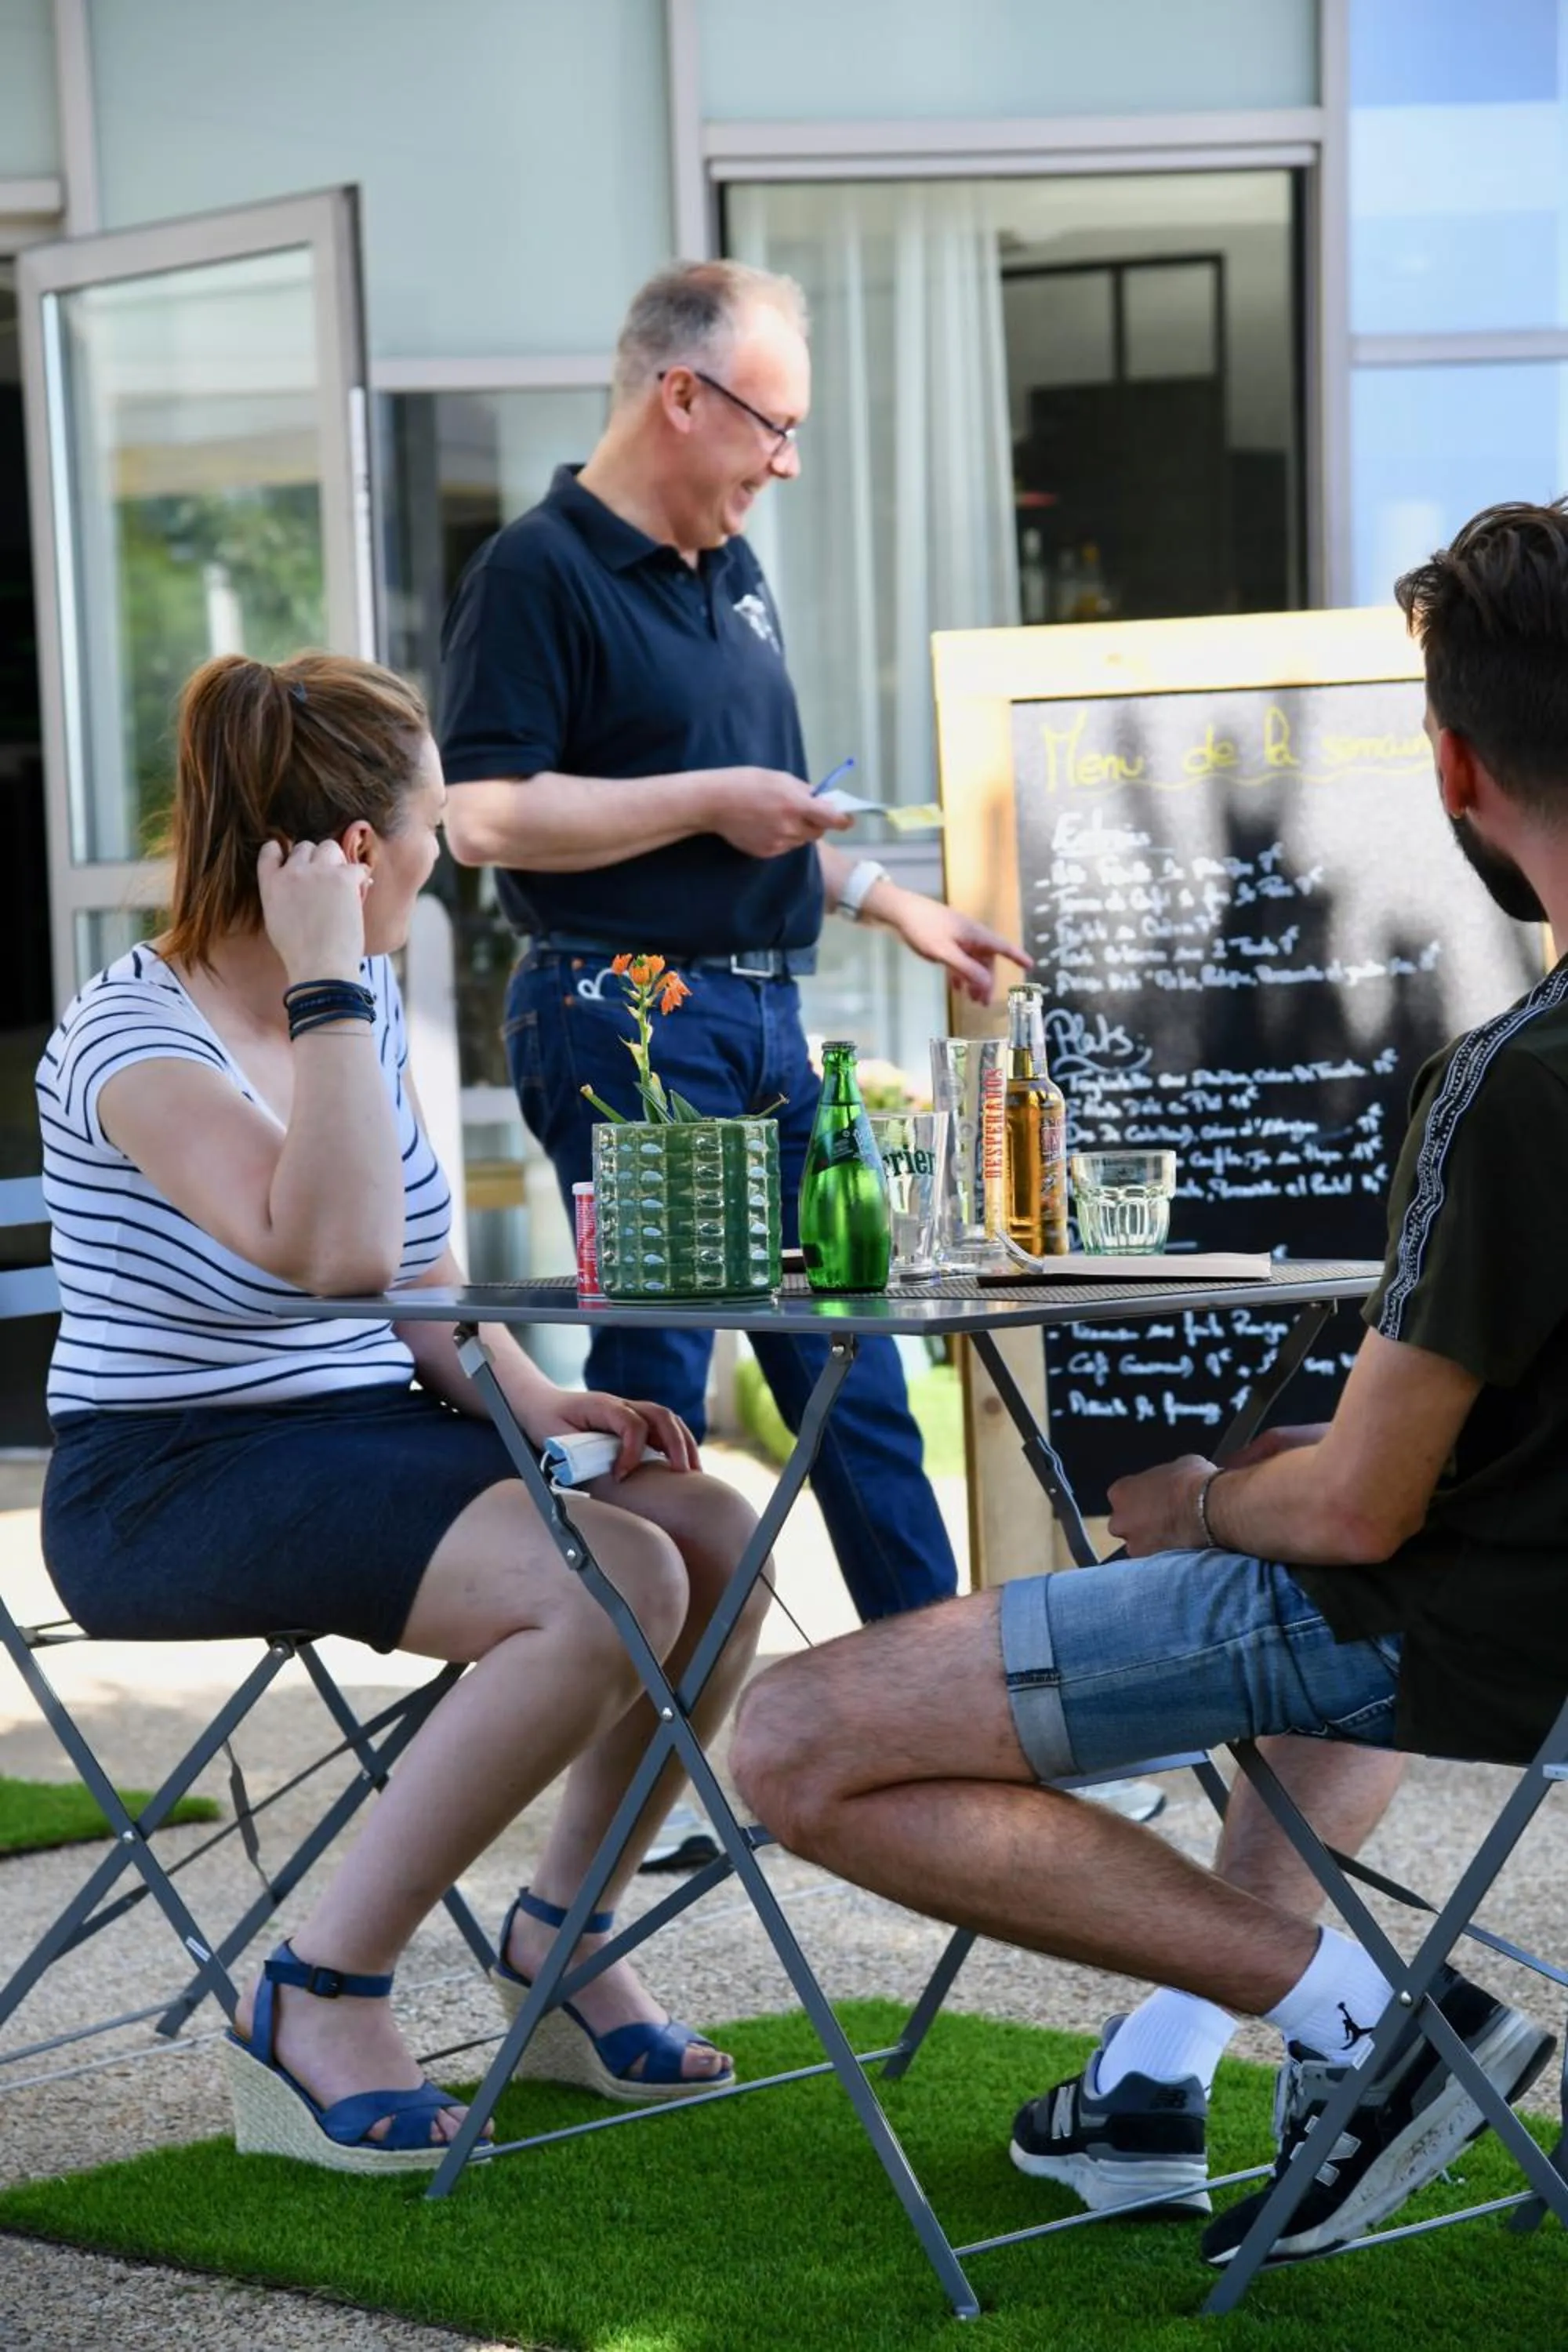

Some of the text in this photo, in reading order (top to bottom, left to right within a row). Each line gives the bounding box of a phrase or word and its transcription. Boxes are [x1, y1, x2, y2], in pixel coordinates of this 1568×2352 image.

[1042, 705, 1432, 794] Menu de la semain
[985, 1068, 1004, 1179] DESPERADOS
